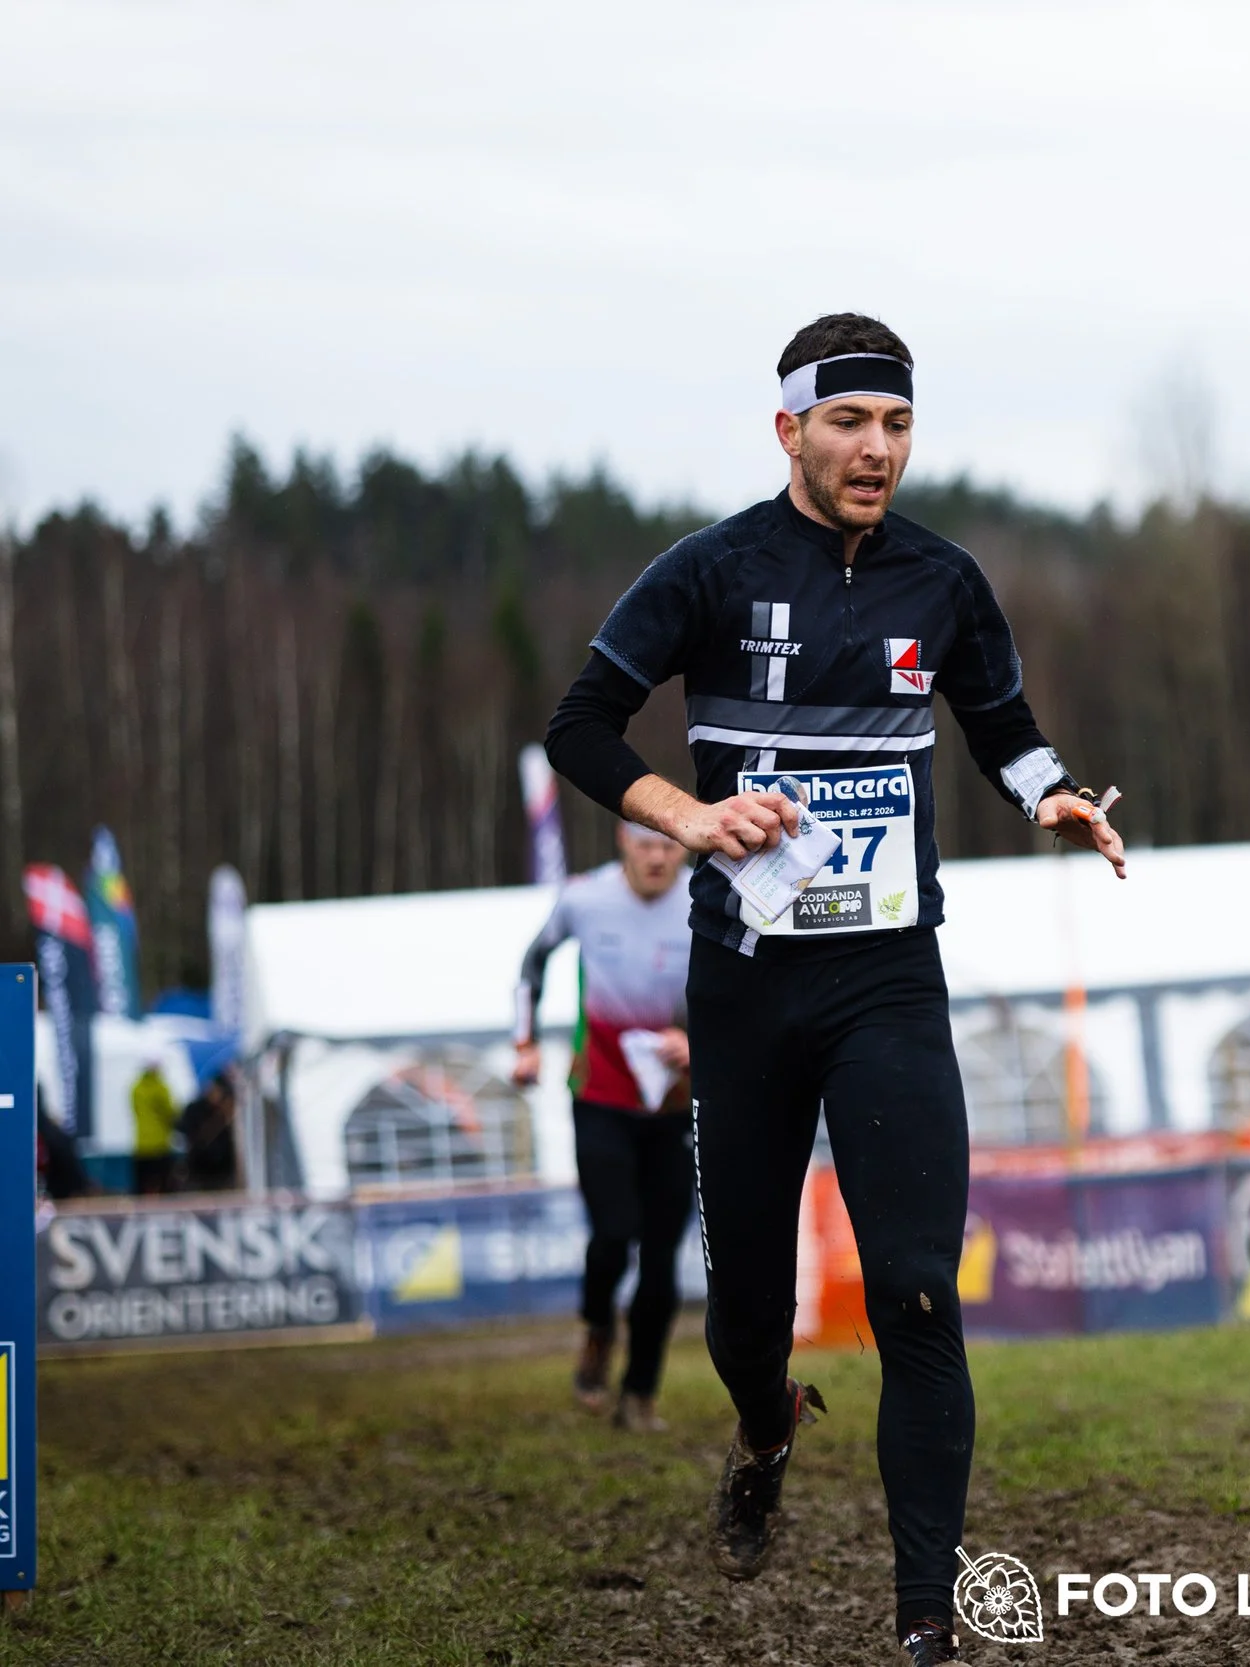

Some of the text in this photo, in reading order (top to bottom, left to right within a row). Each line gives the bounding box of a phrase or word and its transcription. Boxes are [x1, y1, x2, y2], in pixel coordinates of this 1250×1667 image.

[740, 639, 803, 656] TRIMTEX
[810, 810, 842, 819] MEDELN
[874, 806, 895, 816] 2026
[823, 825, 888, 875] 47
[799, 889, 863, 902] GODKÄNDA
[48, 1207, 334, 1290] SVENSK
[48, 1275, 341, 1342] ORIENTERING
